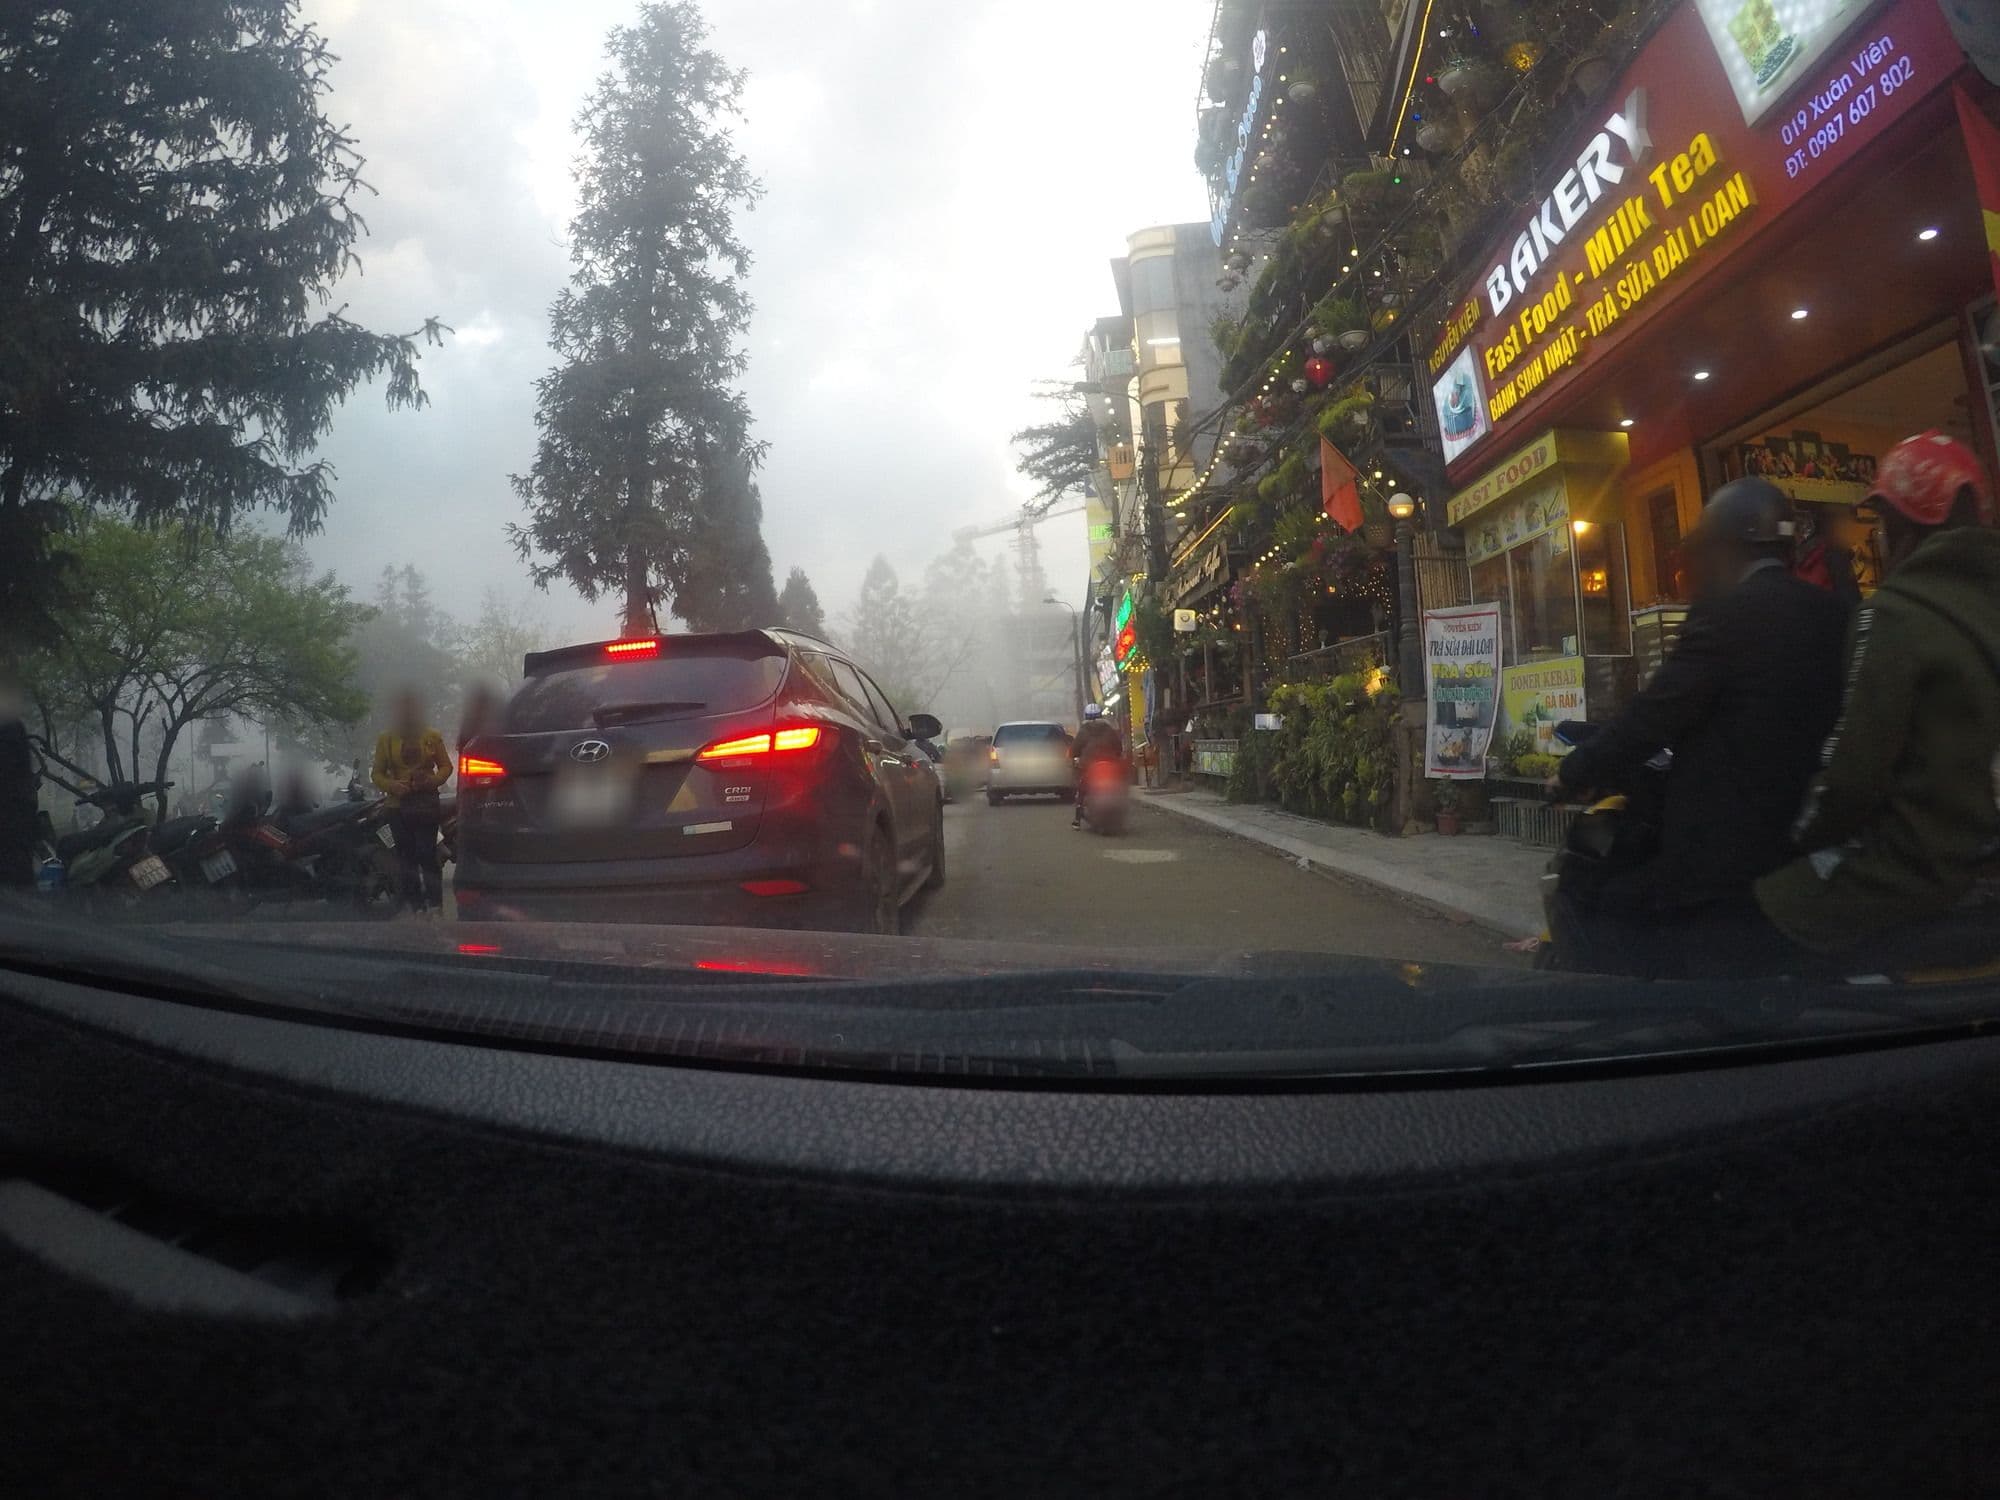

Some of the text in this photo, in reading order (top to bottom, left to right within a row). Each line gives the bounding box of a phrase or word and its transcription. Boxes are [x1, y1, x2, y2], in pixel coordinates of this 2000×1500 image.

[1781, 35, 1894, 145] 019 Xuân Viên
[1785, 55, 1914, 178] ĐT: 0987 607 802
[1484, 324, 1522, 380] Fast
[1519, 271, 1572, 344] Food
[1584, 195, 1652, 279] Milk
[1649, 132, 1717, 209] Tea
[1486, 86, 1652, 317] BAKERY
[1488, 382, 1518, 422] BÁNH
[1516, 358, 1545, 398] SINH
[1543, 325, 1578, 376] NHẬT
[1585, 286, 1619, 337] TRÀ
[1616, 261, 1656, 311] SỮA
[1652, 229, 1689, 280] ĐÀI
[1688, 171, 1750, 249] LOAN
[1452, 446, 1547, 521] FAST FOOD
